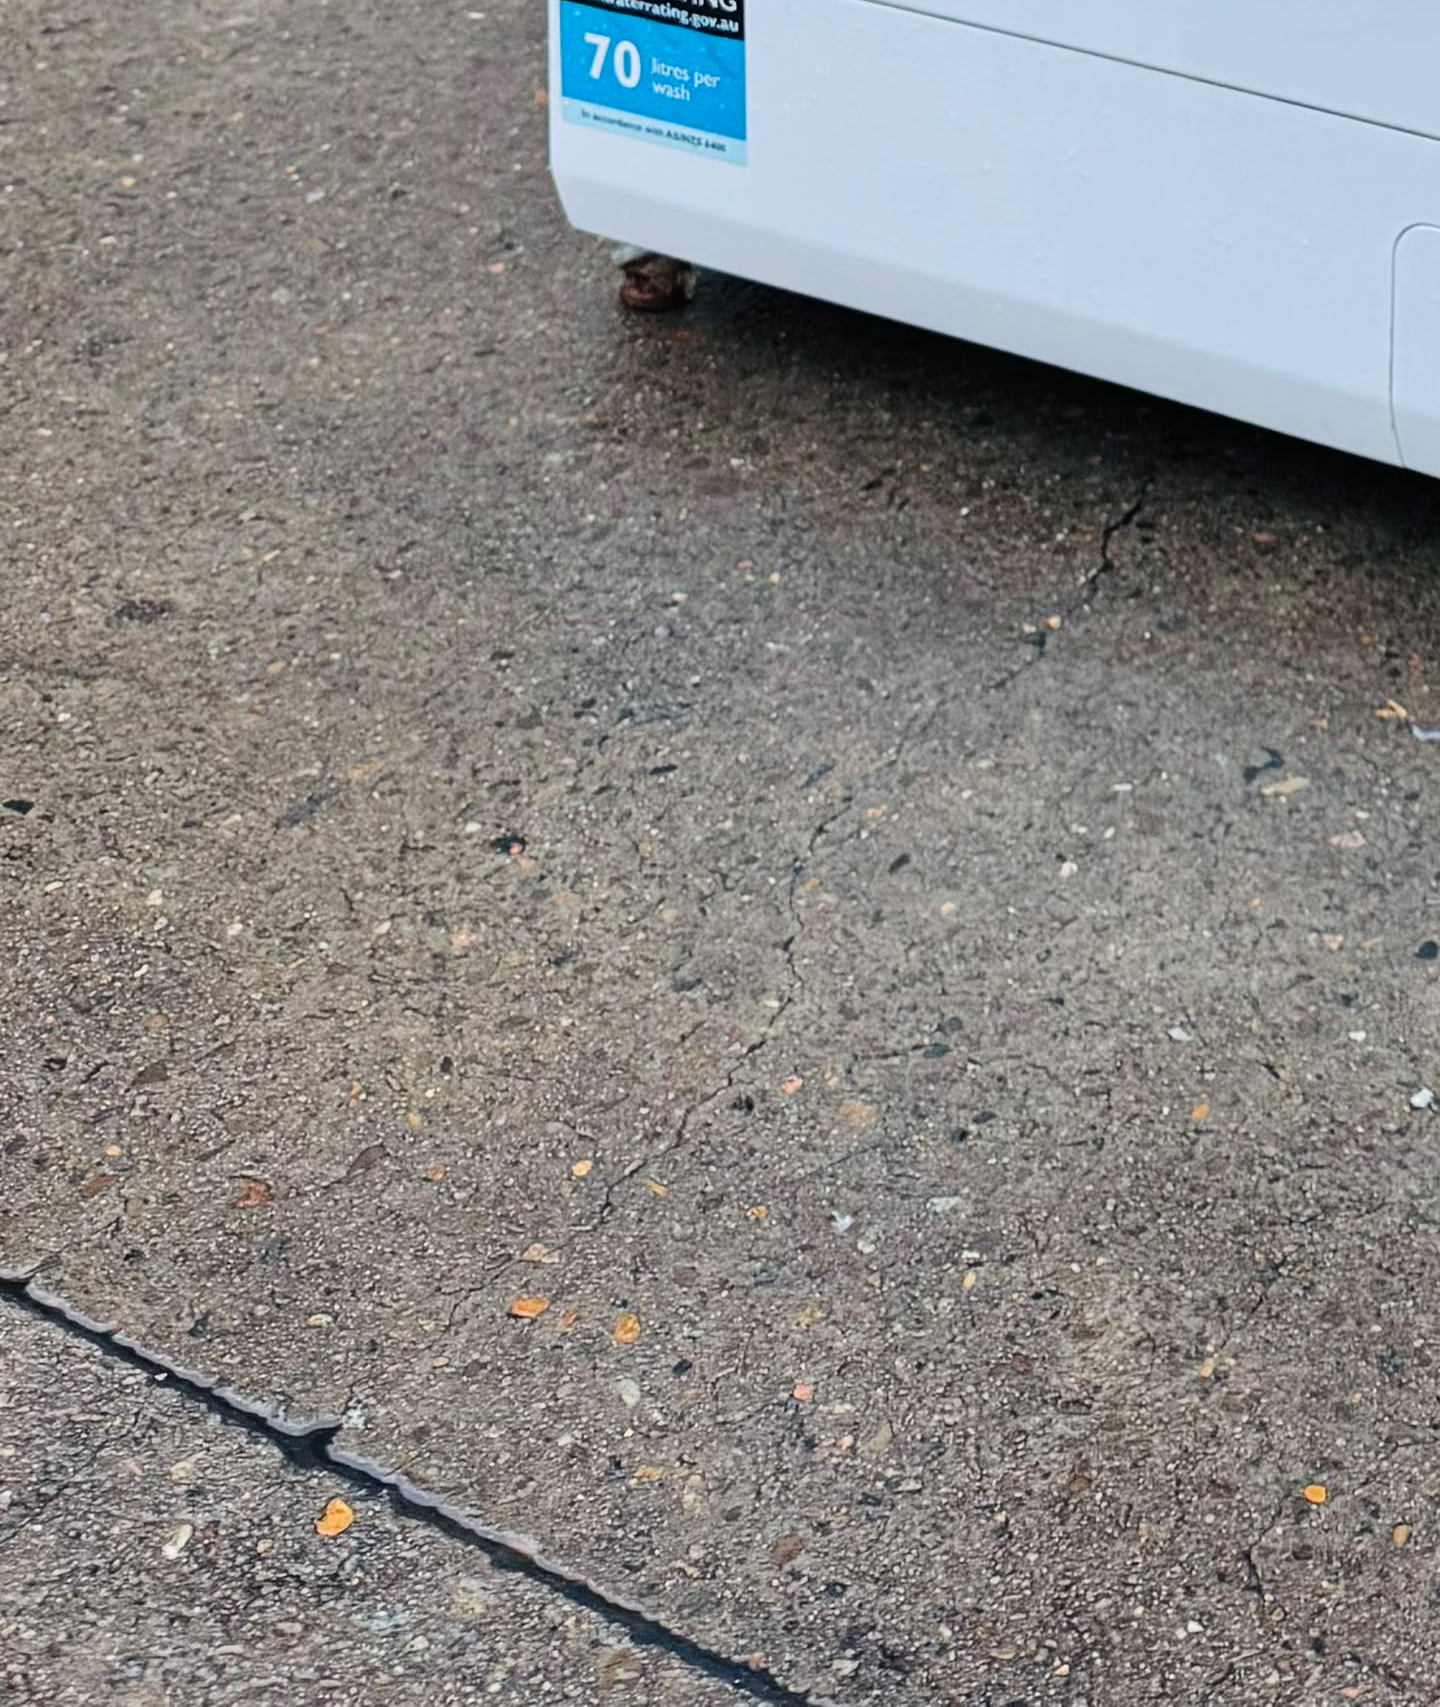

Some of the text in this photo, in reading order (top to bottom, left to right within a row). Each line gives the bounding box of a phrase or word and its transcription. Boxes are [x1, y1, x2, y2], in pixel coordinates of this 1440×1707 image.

[584, 32, 641, 88] 70
[651, 57, 720, 88] litres per
[652, 82, 690, 101] wash
